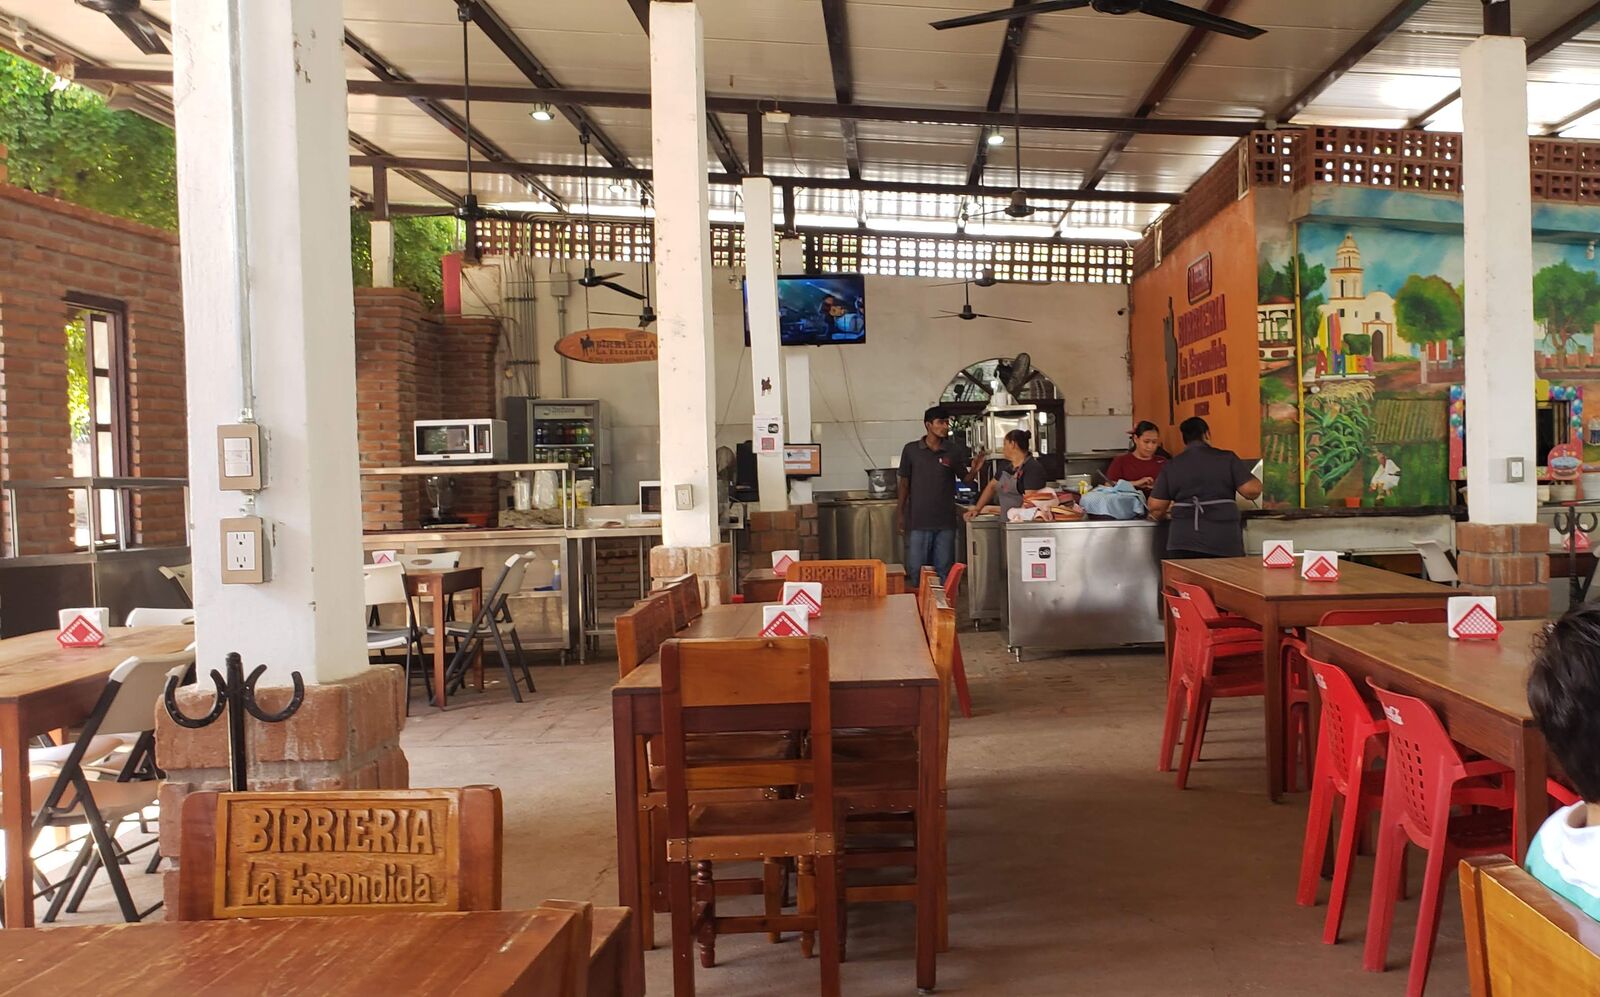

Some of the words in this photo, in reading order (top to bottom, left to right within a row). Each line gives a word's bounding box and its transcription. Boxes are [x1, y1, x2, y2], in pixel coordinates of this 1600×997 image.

[801, 566, 869, 581] BIRRIERIA
[824, 582, 869, 597] scondida
[242, 807, 435, 854] BIRRIERIA
[242, 862, 277, 905] La
[286, 862, 433, 904] Escondida
